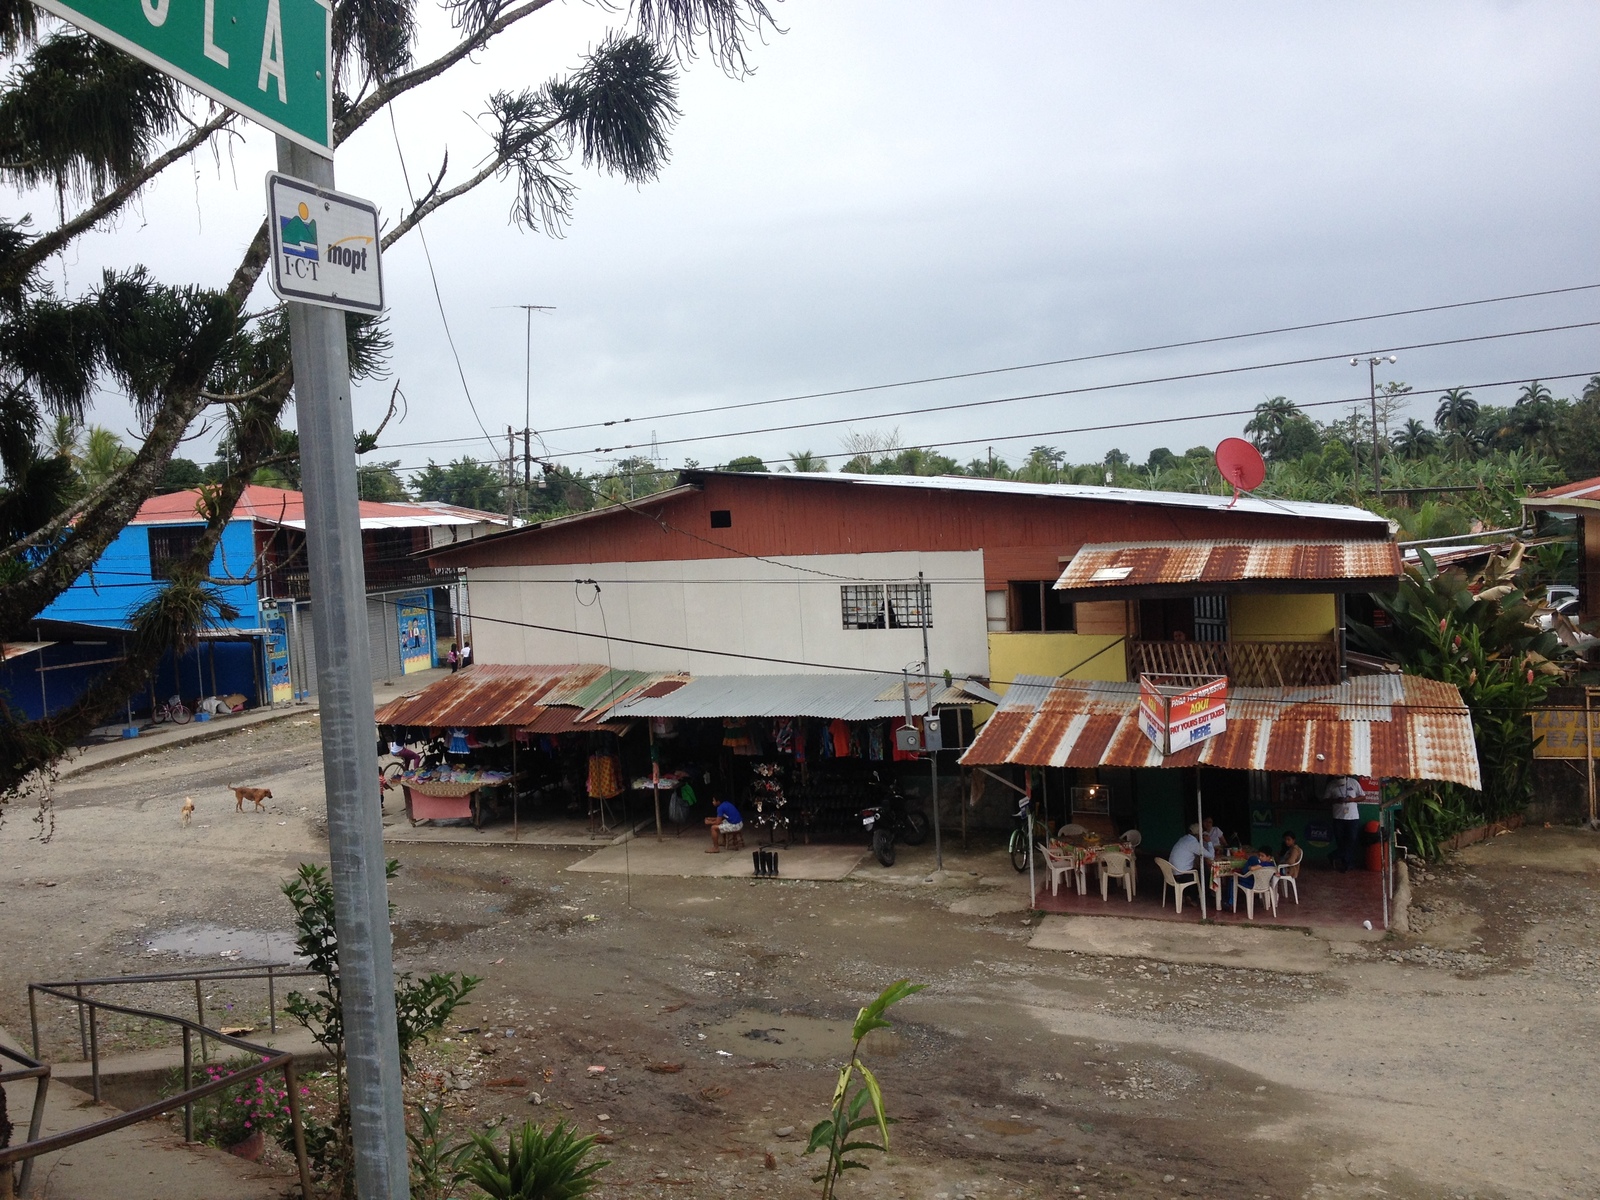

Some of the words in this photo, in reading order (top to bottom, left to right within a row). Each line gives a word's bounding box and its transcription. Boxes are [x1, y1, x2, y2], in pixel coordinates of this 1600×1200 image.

[141, 0, 287, 104] LA
[327, 244, 367, 274] mopt
[1170, 725, 1180, 735] PAY
[1181, 718, 1198, 731] YOURS
[1198, 714, 1210, 724] EXIT
[1210, 708, 1225, 718] TAXES
[1190, 723, 1211, 742] HERE
